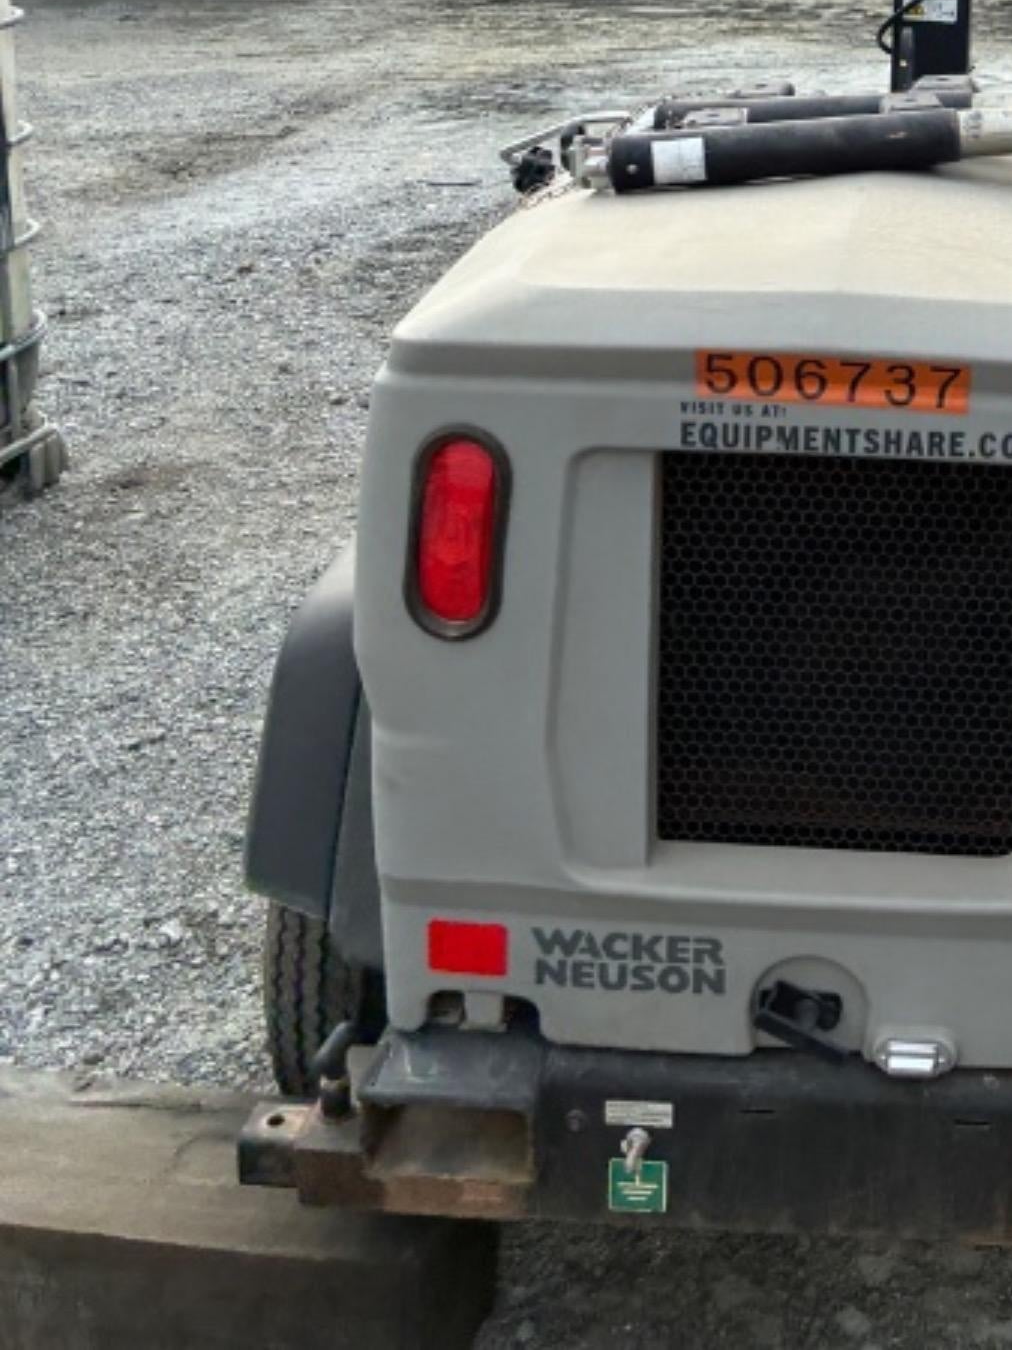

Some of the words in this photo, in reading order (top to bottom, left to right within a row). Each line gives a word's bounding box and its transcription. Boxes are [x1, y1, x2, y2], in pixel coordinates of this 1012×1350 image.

[704, 352, 962, 409] 506737
[680, 401, 724, 415] VISIT
[732, 404, 754, 417] US
[531, 926, 725, 965] WACKER
[534, 958, 727, 996] NEUSON
